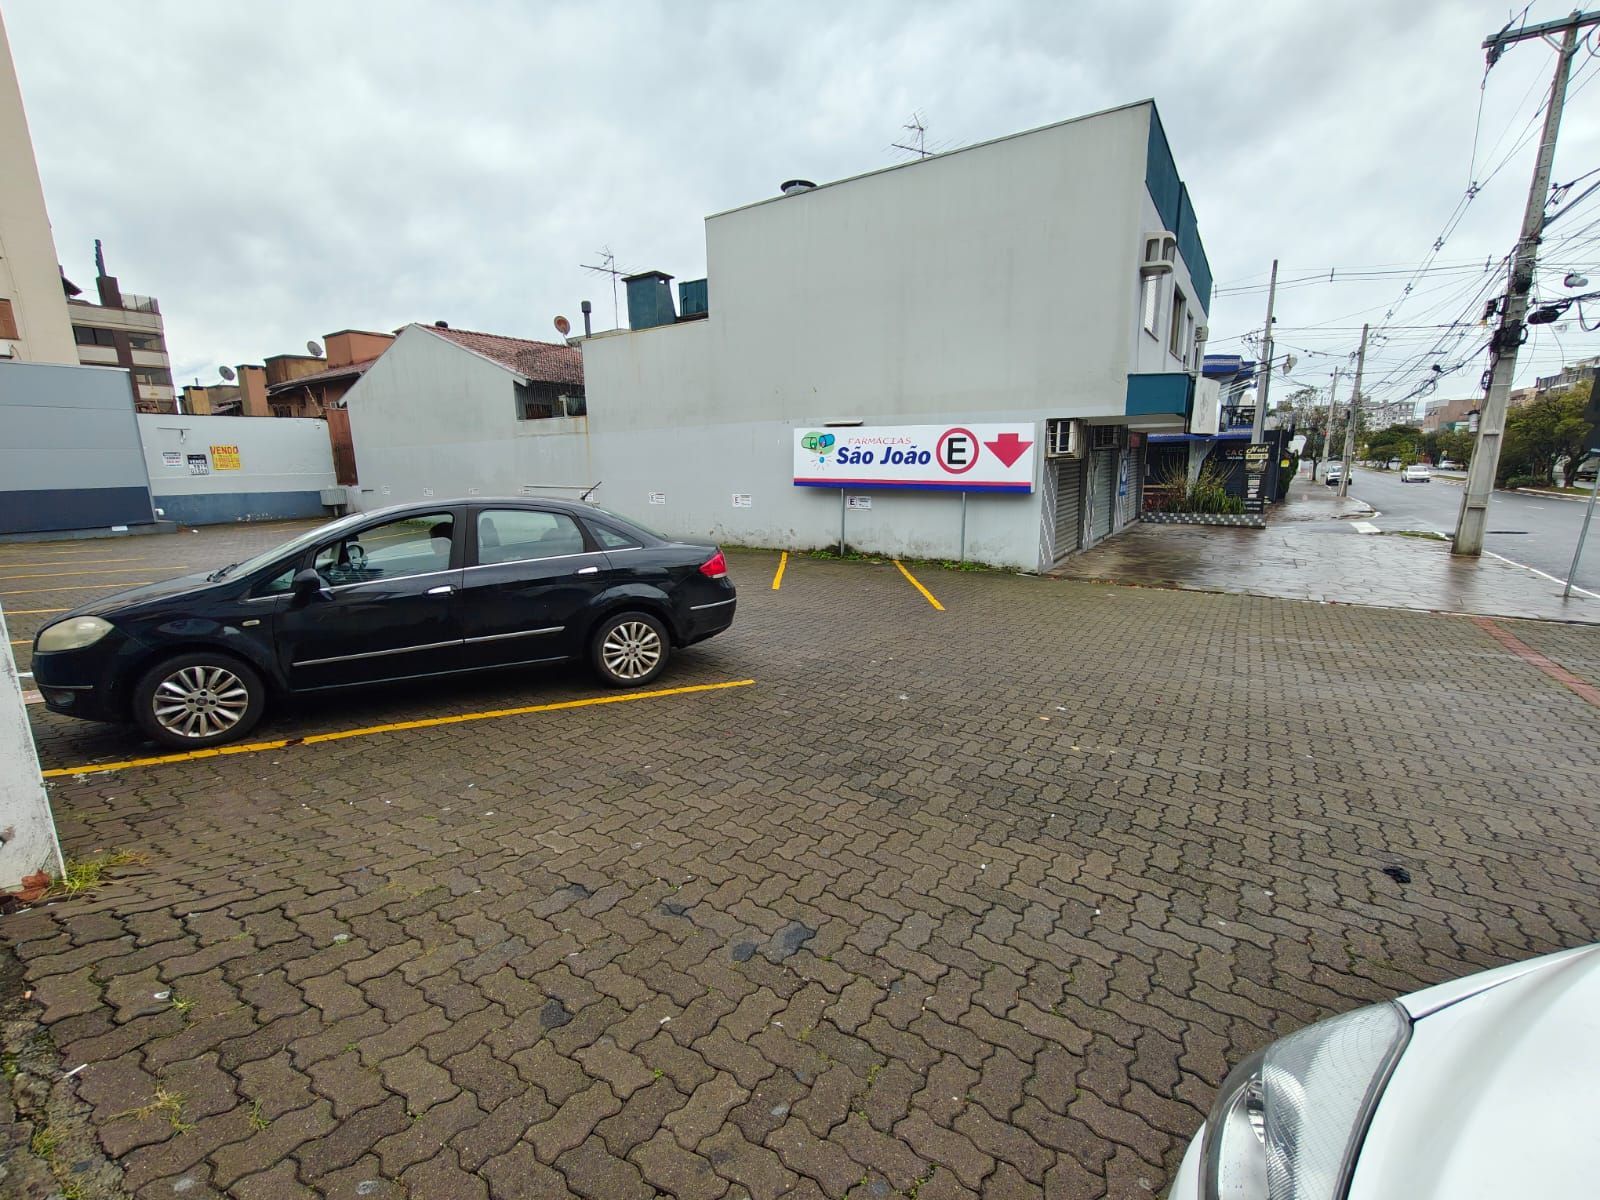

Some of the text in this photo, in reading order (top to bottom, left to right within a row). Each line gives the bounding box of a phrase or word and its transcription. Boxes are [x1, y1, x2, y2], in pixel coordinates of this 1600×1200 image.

[209, 445, 239, 455] VENDO
[836, 445, 932, 466] São João
[946, 437, 967, 465] E
